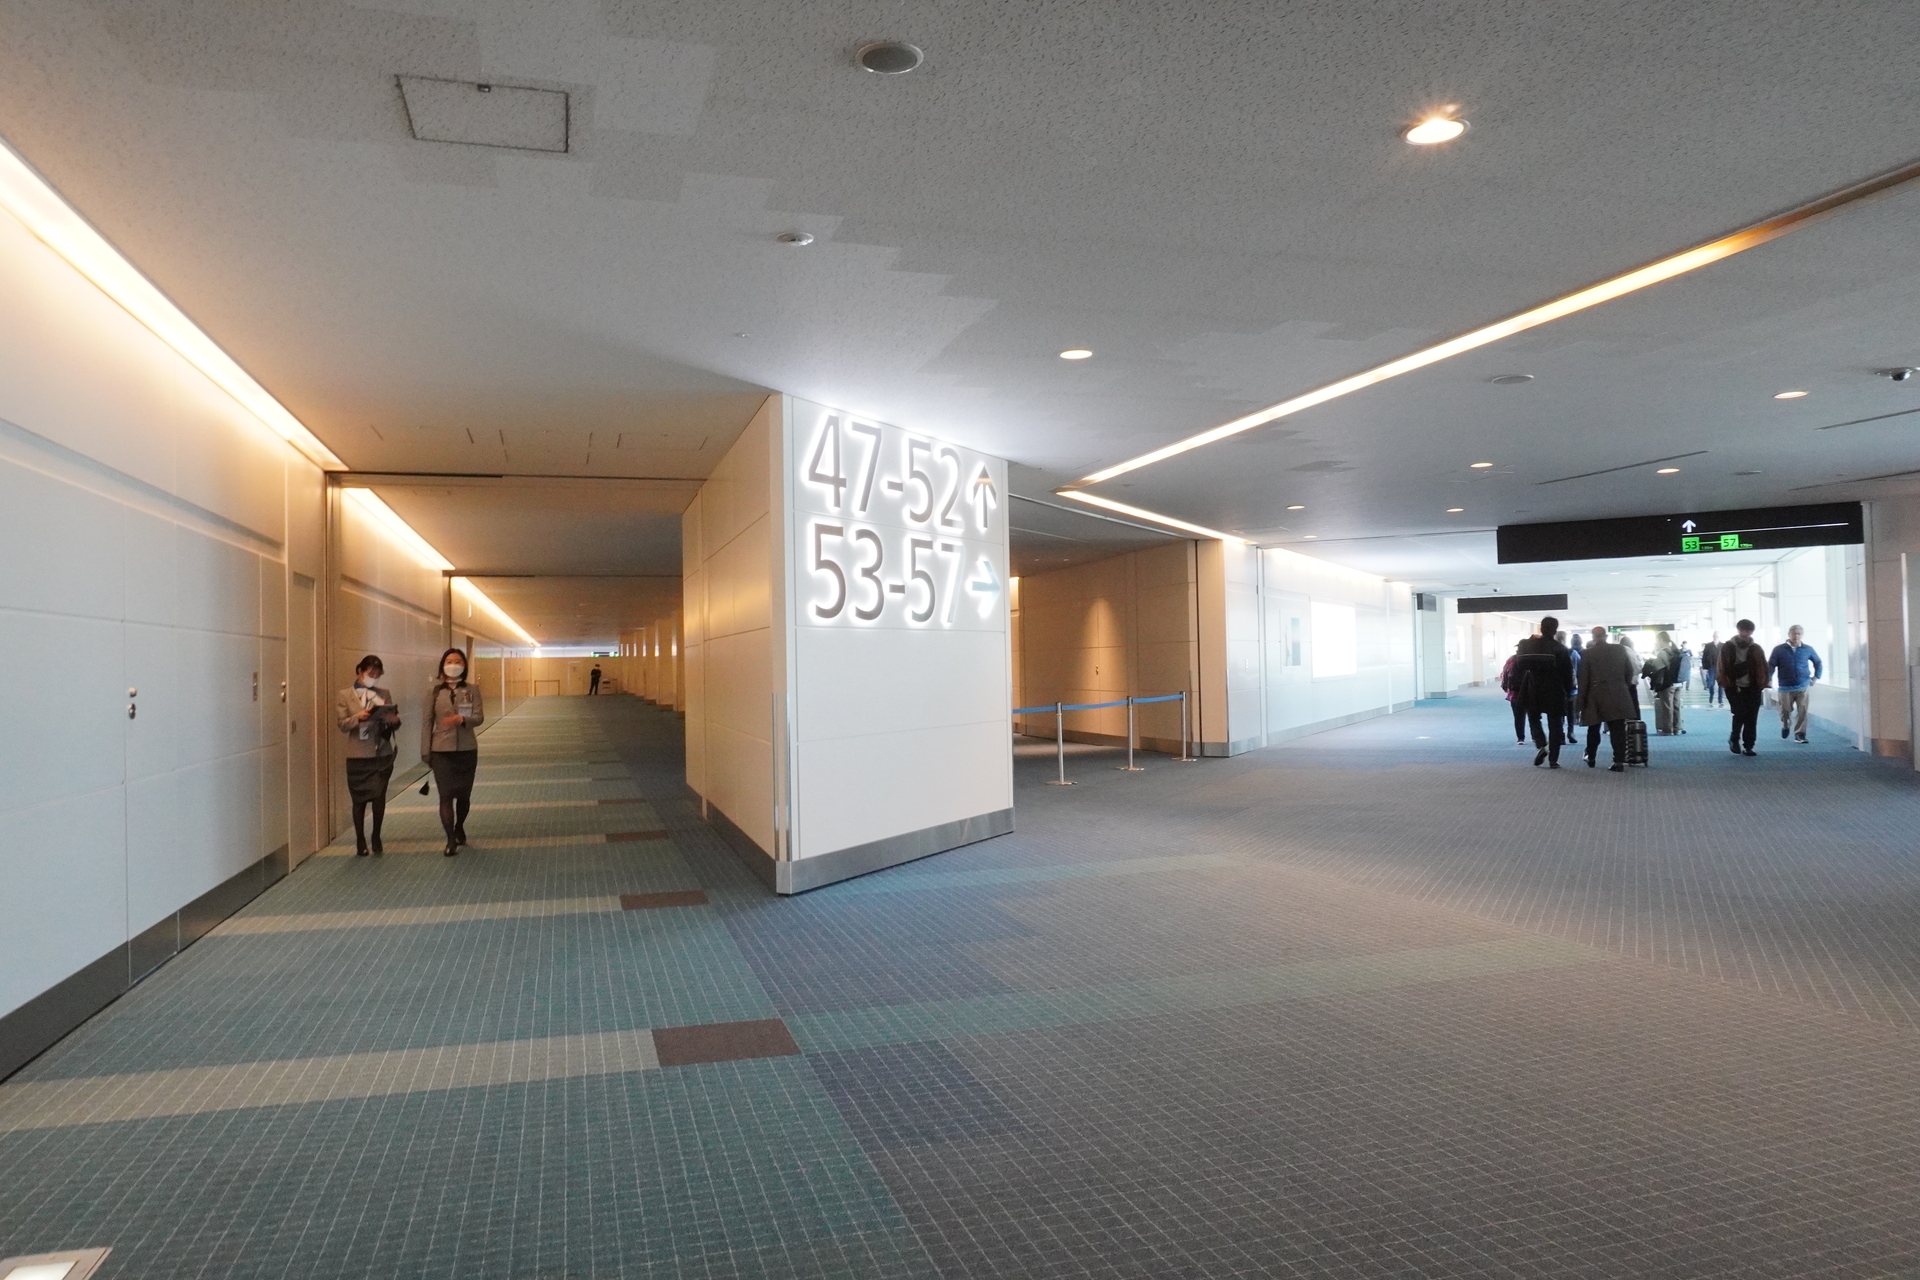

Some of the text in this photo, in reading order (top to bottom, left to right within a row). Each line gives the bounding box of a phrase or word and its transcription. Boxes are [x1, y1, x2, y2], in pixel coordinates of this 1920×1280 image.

[808, 415, 964, 527] 47-52
[814, 523, 965, 623] 53-57
[1684, 540, 1698, 550] 53
[1723, 538, 1736, 548] 57
